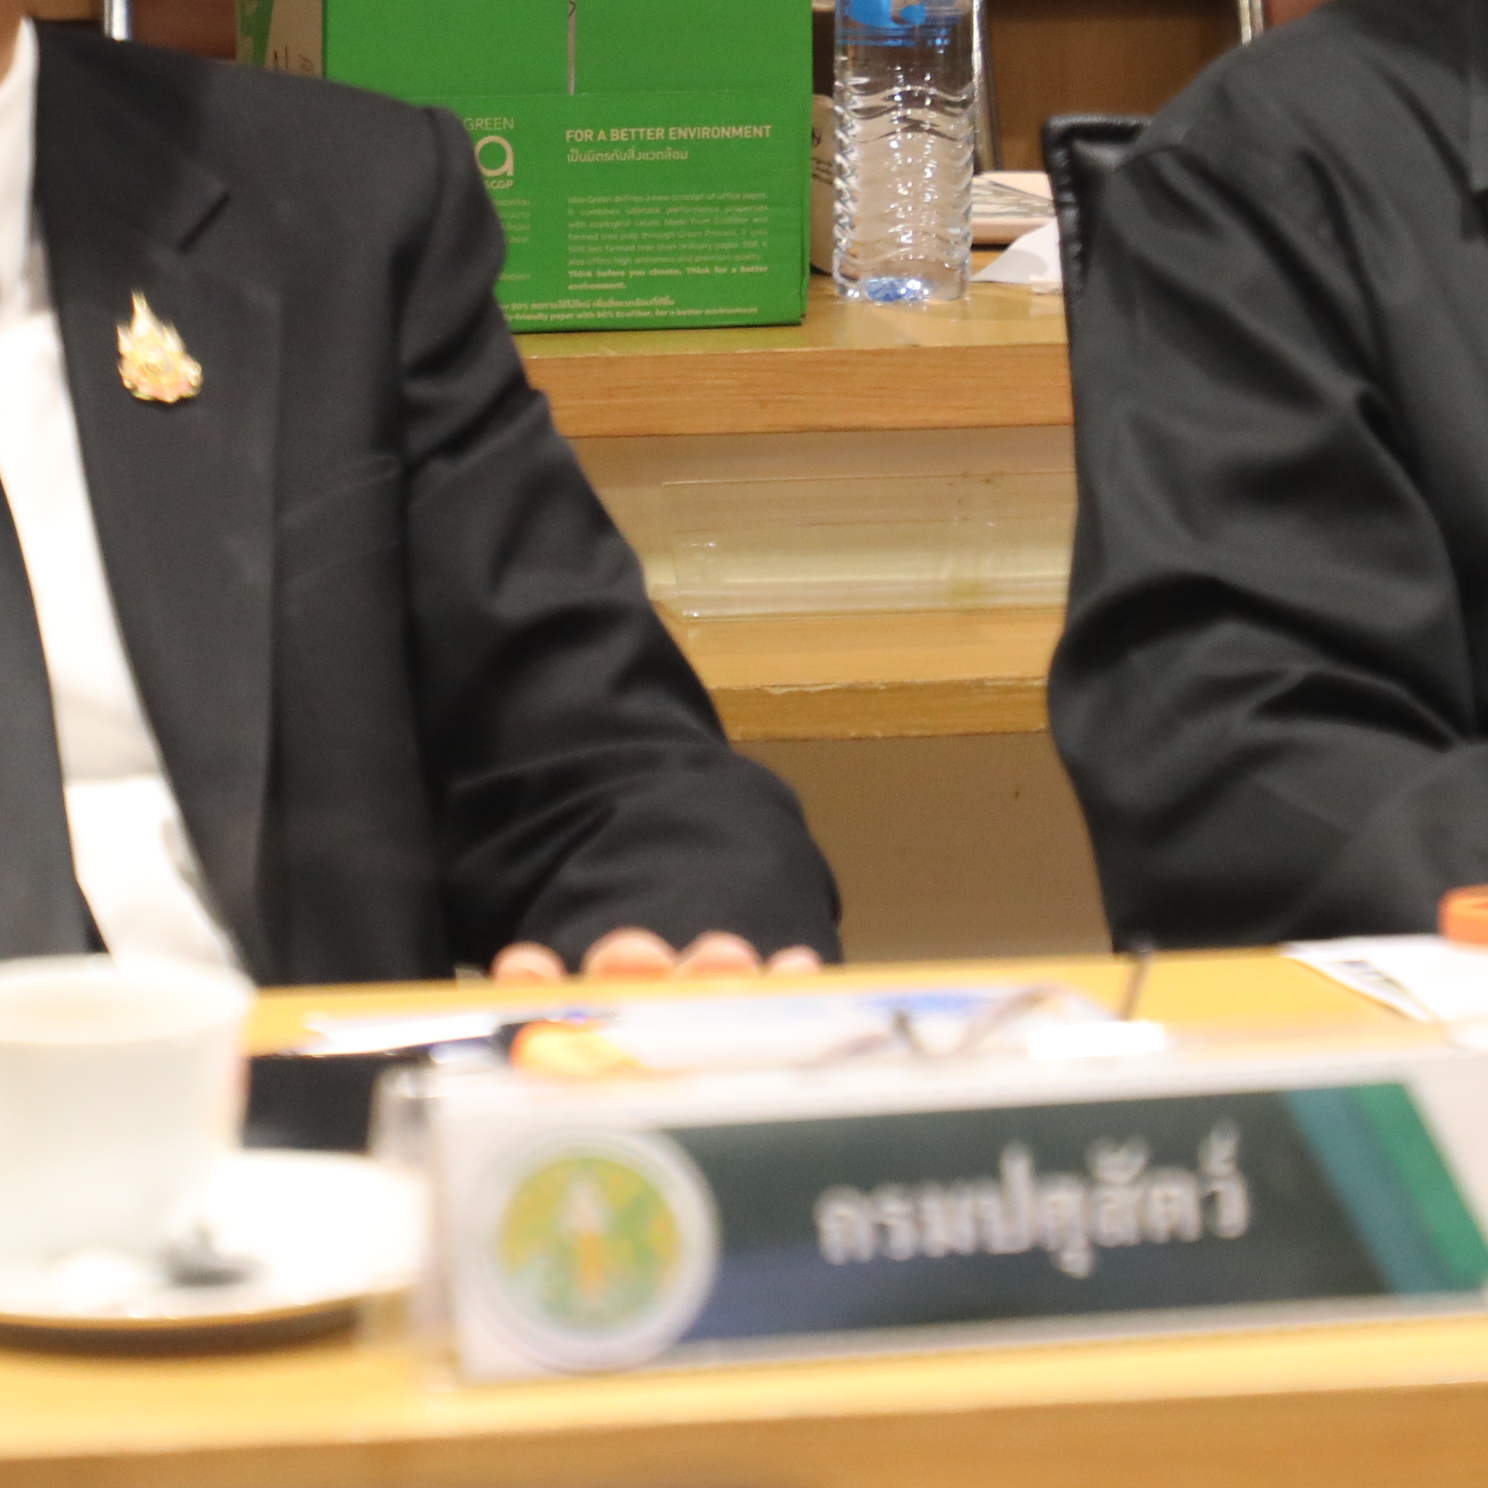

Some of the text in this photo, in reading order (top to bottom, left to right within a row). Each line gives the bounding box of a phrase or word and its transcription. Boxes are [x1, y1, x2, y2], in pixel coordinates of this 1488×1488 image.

[566, 125, 773, 142] FOR A BETTER ENVIRONMENT
